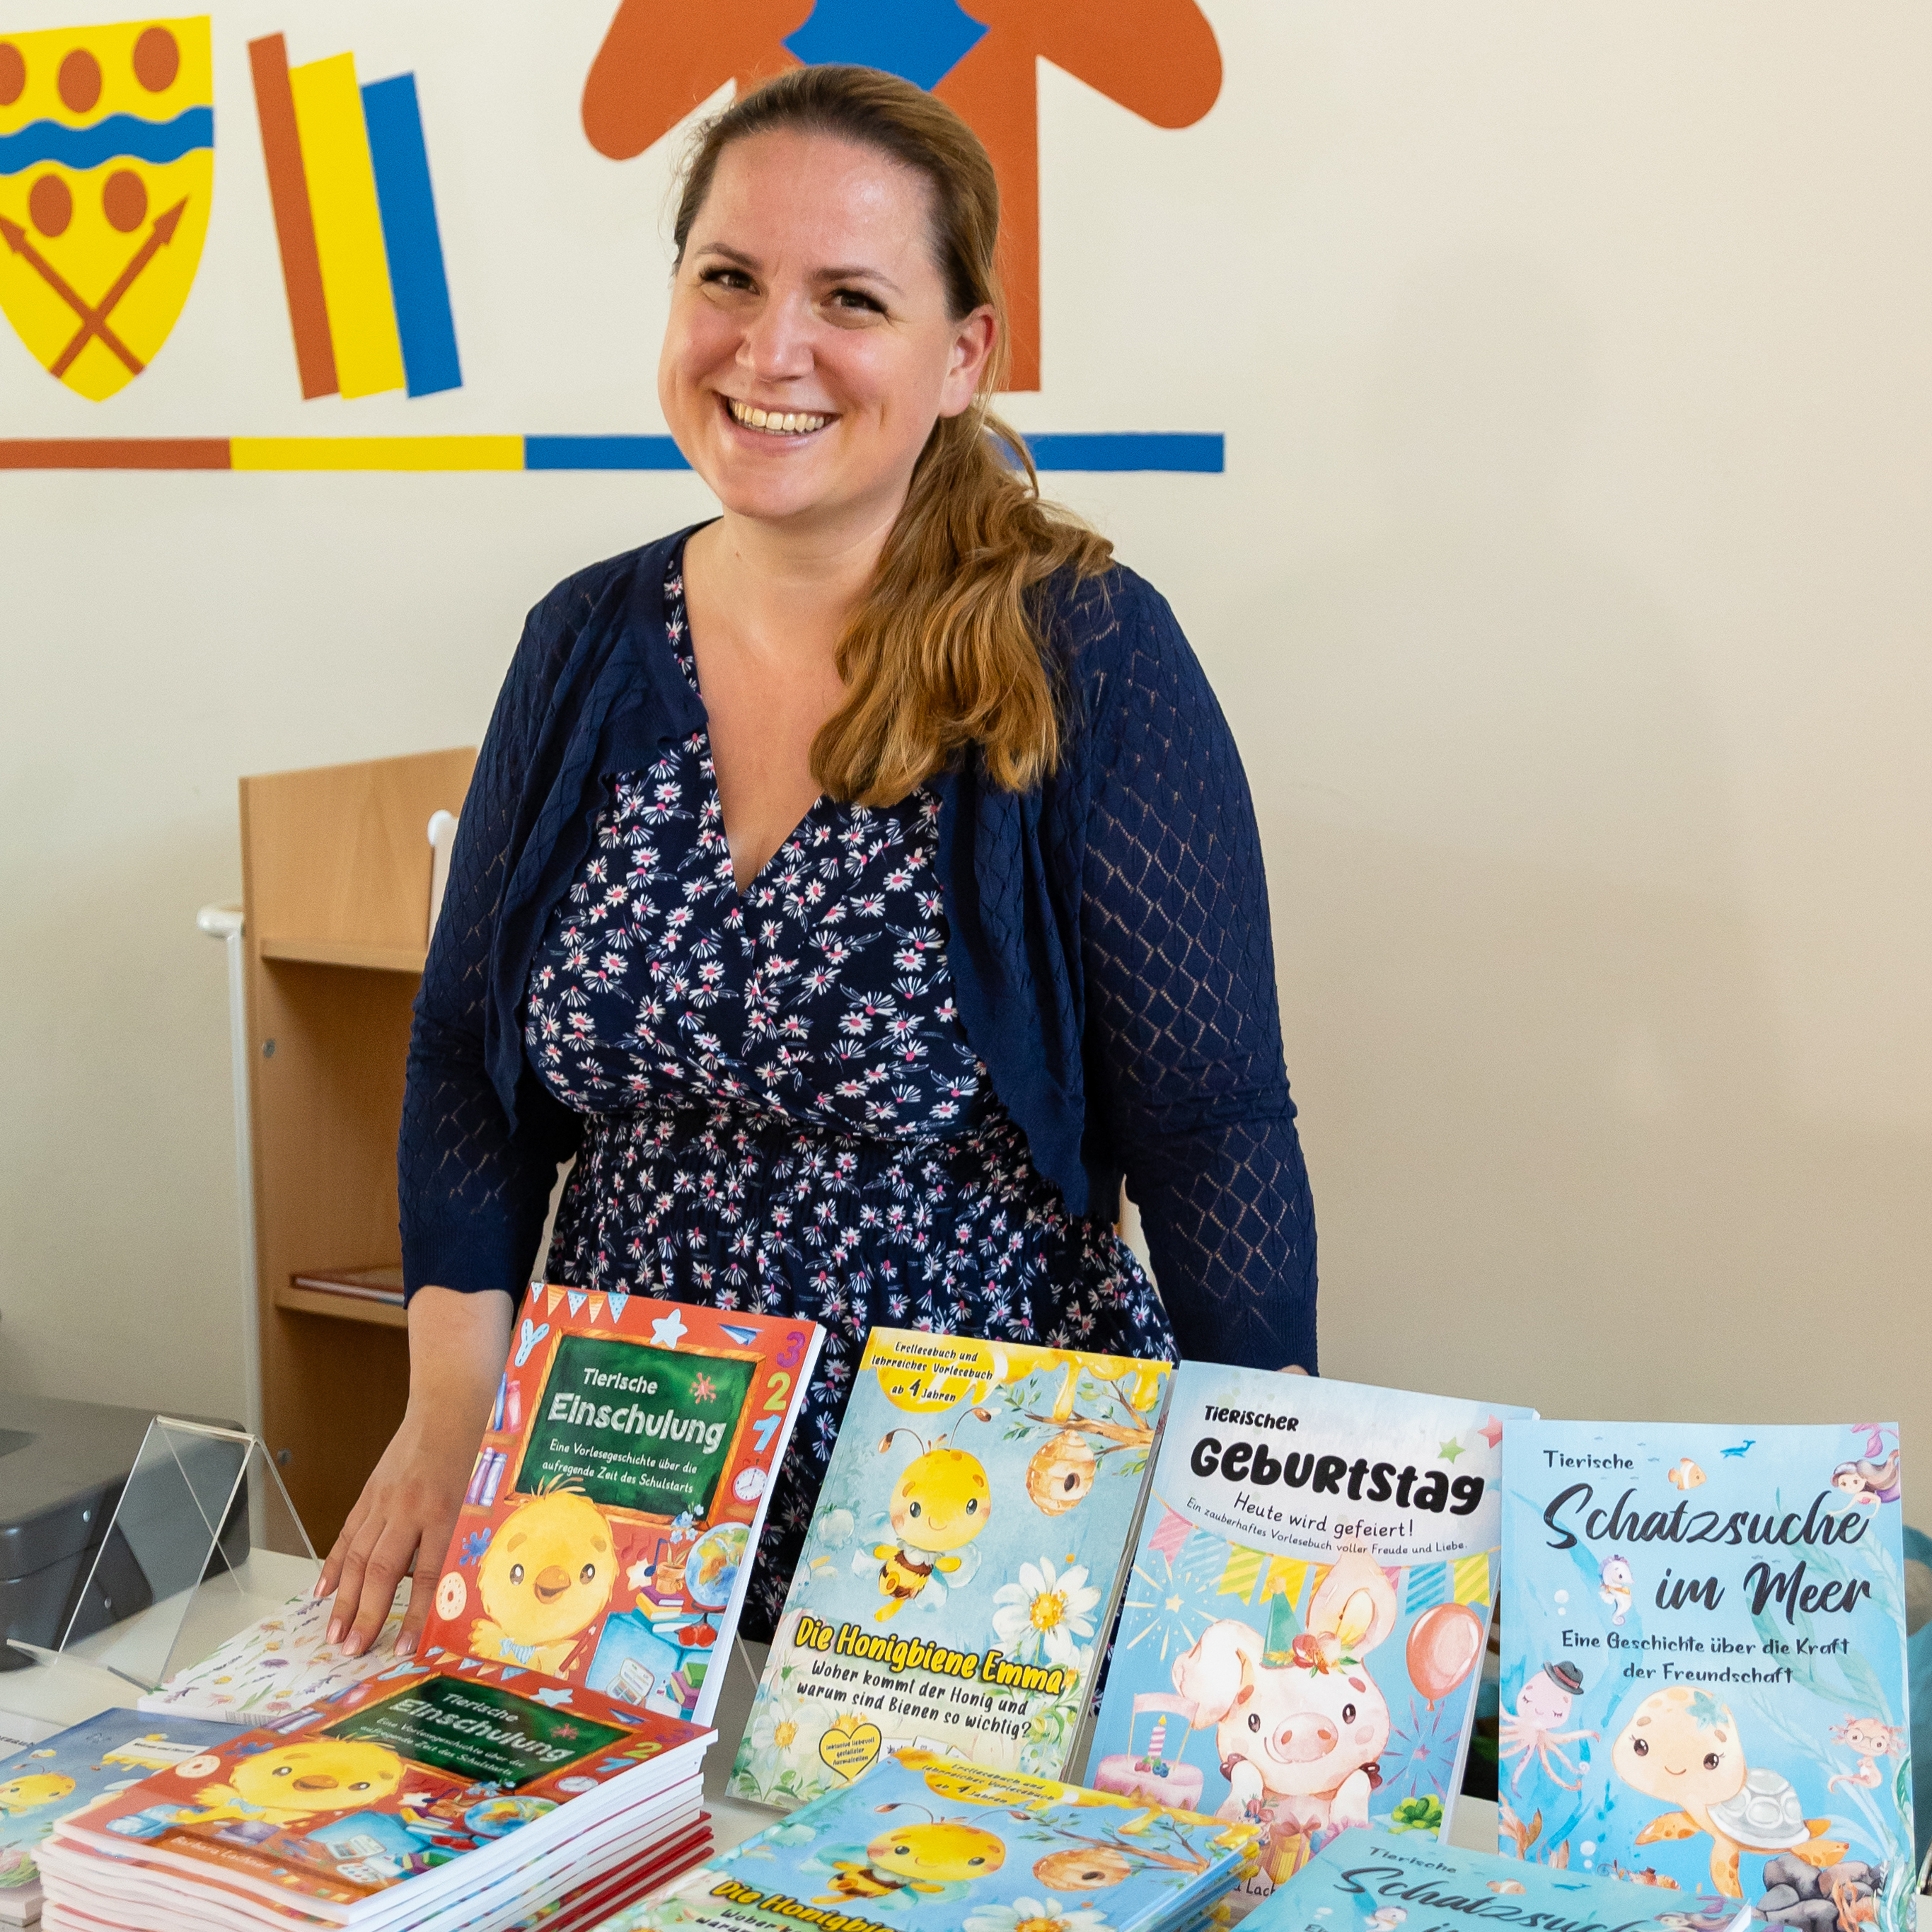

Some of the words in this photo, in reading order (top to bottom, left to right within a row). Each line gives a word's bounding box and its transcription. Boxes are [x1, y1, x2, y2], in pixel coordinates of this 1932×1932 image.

[777, 1331, 806, 1367] 3
[872, 1355, 927, 1371] lehrreiches
[933, 1363, 993, 1380] Vorlesebuch
[894, 1341, 956, 1359] Erstlesebuch
[959, 1353, 978, 1362] und
[584, 1367, 658, 1394] Tierische
[763, 1372, 791, 1411] 2
[891, 1384, 904, 1394] ab
[909, 1379, 922, 1396] 4
[921, 1389, 956, 1402] Jahren
[548, 1392, 727, 1454] Einschulung
[753, 1414, 782, 1454] 1
[550, 1438, 569, 1453] Eine
[574, 1442, 656, 1468] Vorlesegeschichte
[659, 1458, 680, 1471] über
[683, 1461, 698, 1474] die
[1543, 1450, 1635, 1470] Tierische
[542, 1460, 595, 1476] aufregende
[597, 1467, 618, 1481] Zeit
[620, 1471, 636, 1484] des
[639, 1474, 693, 1493] Schulstarts
[1186, 1496, 1201, 1512] Ein
[1204, 1508, 1267, 1537] zauberhaftes
[1271, 1529, 1332, 1551] Vorlesebuch
[1336, 1544, 1368, 1554] voller
[1372, 1544, 1408, 1554] Freude
[1411, 1543, 1433, 1554] und
[1435, 1541, 1468, 1552] Liebe.
[1234, 1491, 1283, 1522] Heute
[1290, 1515, 1327, 1532] wird
[1334, 1519, 1414, 1539] gefeiert!
[1543, 1483, 1870, 1549] Schatzsuche
[1655, 1568, 1725, 1611] im
[1743, 1560, 1872, 1626] Meer
[794, 1615, 835, 1651] Die
[835, 1621, 980, 1679] Honigbiene
[982, 1648, 1066, 1696] Emma
[1561, 1629, 1601, 1648] Eine
[1607, 1631, 1705, 1653] Geschichte
[1711, 1638, 1756, 1654] über
[1762, 1638, 1791, 1654] die
[1796, 1638, 1850, 1655] Kraft
[812, 1660, 858, 1682] Woher
[862, 1670, 915, 1694] kommt
[919, 1681, 946, 1699] der
[950, 1687, 991, 1711] Honig
[998, 1699, 1029, 1716] und
[1623, 1662, 1657, 1679] der
[1662, 1662, 1793, 1684] Freundschaft
[442, 1693, 519, 1722] Tierische
[797, 1682, 848, 1702] warum
[852, 1691, 882, 1710] sind
[889, 1696, 939, 1721] Bienen
[943, 1711, 960, 1725] so
[965, 1714, 1032, 1740] wichtig?
[388, 1699, 576, 1762] Einschulung
[1370, 1846, 1457, 1873] Tierische
[710, 1880, 765, 1904] Die
[756, 1893, 908, 1932] Honigbi
[1334, 1867, 1650, 1932] Schatzsu
[695, 1917, 751, 1932] waru
